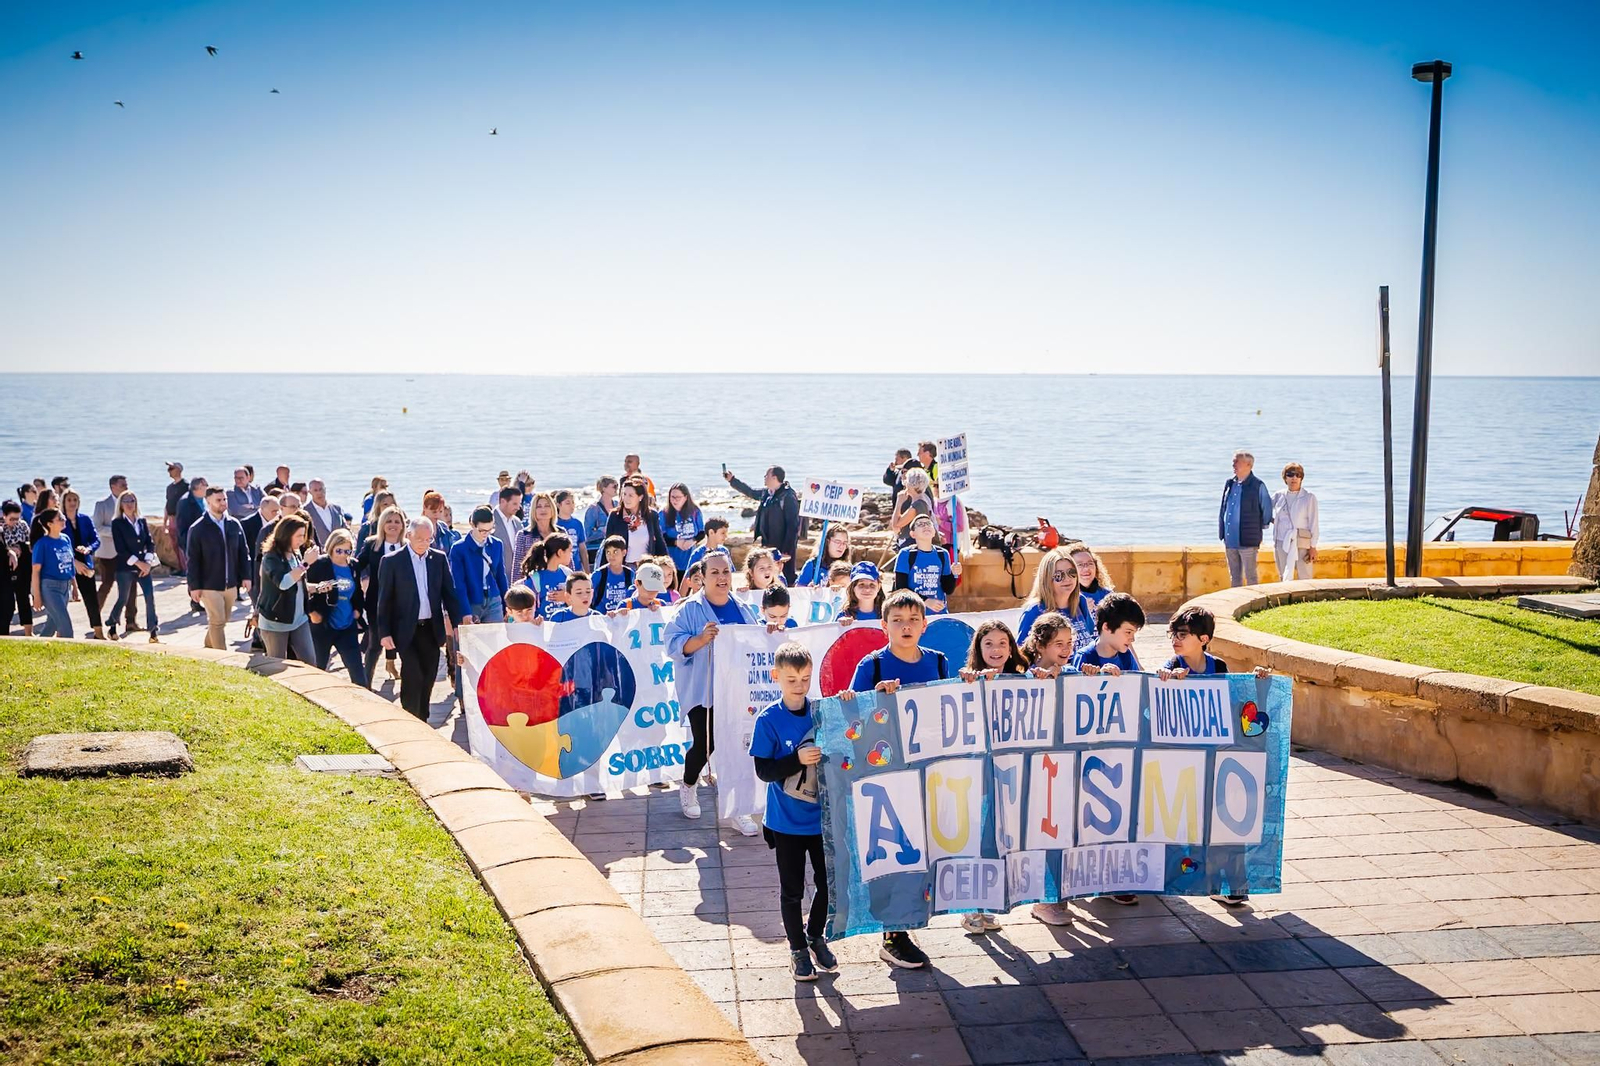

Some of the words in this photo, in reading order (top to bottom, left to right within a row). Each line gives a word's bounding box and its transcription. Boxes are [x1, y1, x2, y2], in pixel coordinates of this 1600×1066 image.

[824, 484, 843, 500] CEIP
[803, 500, 820, 514] LAS
[820, 502, 857, 519] MARINAS
[628, 629, 642, 650] 2
[649, 622, 666, 646] D
[751, 652, 756, 666] 2
[757, 652, 766, 666] DE
[748, 667, 761, 684] DÍA
[904, 699, 921, 754] 2
[940, 692, 976, 748] DE
[991, 688, 1048, 743] ABRIL
[1075, 681, 1126, 736] DÍA
[1155, 687, 1229, 738] MUNDIAL
[861, 753, 1258, 866] AUTISMO
[939, 864, 998, 901] CEIP
[1063, 848, 1149, 892] MARINAS
